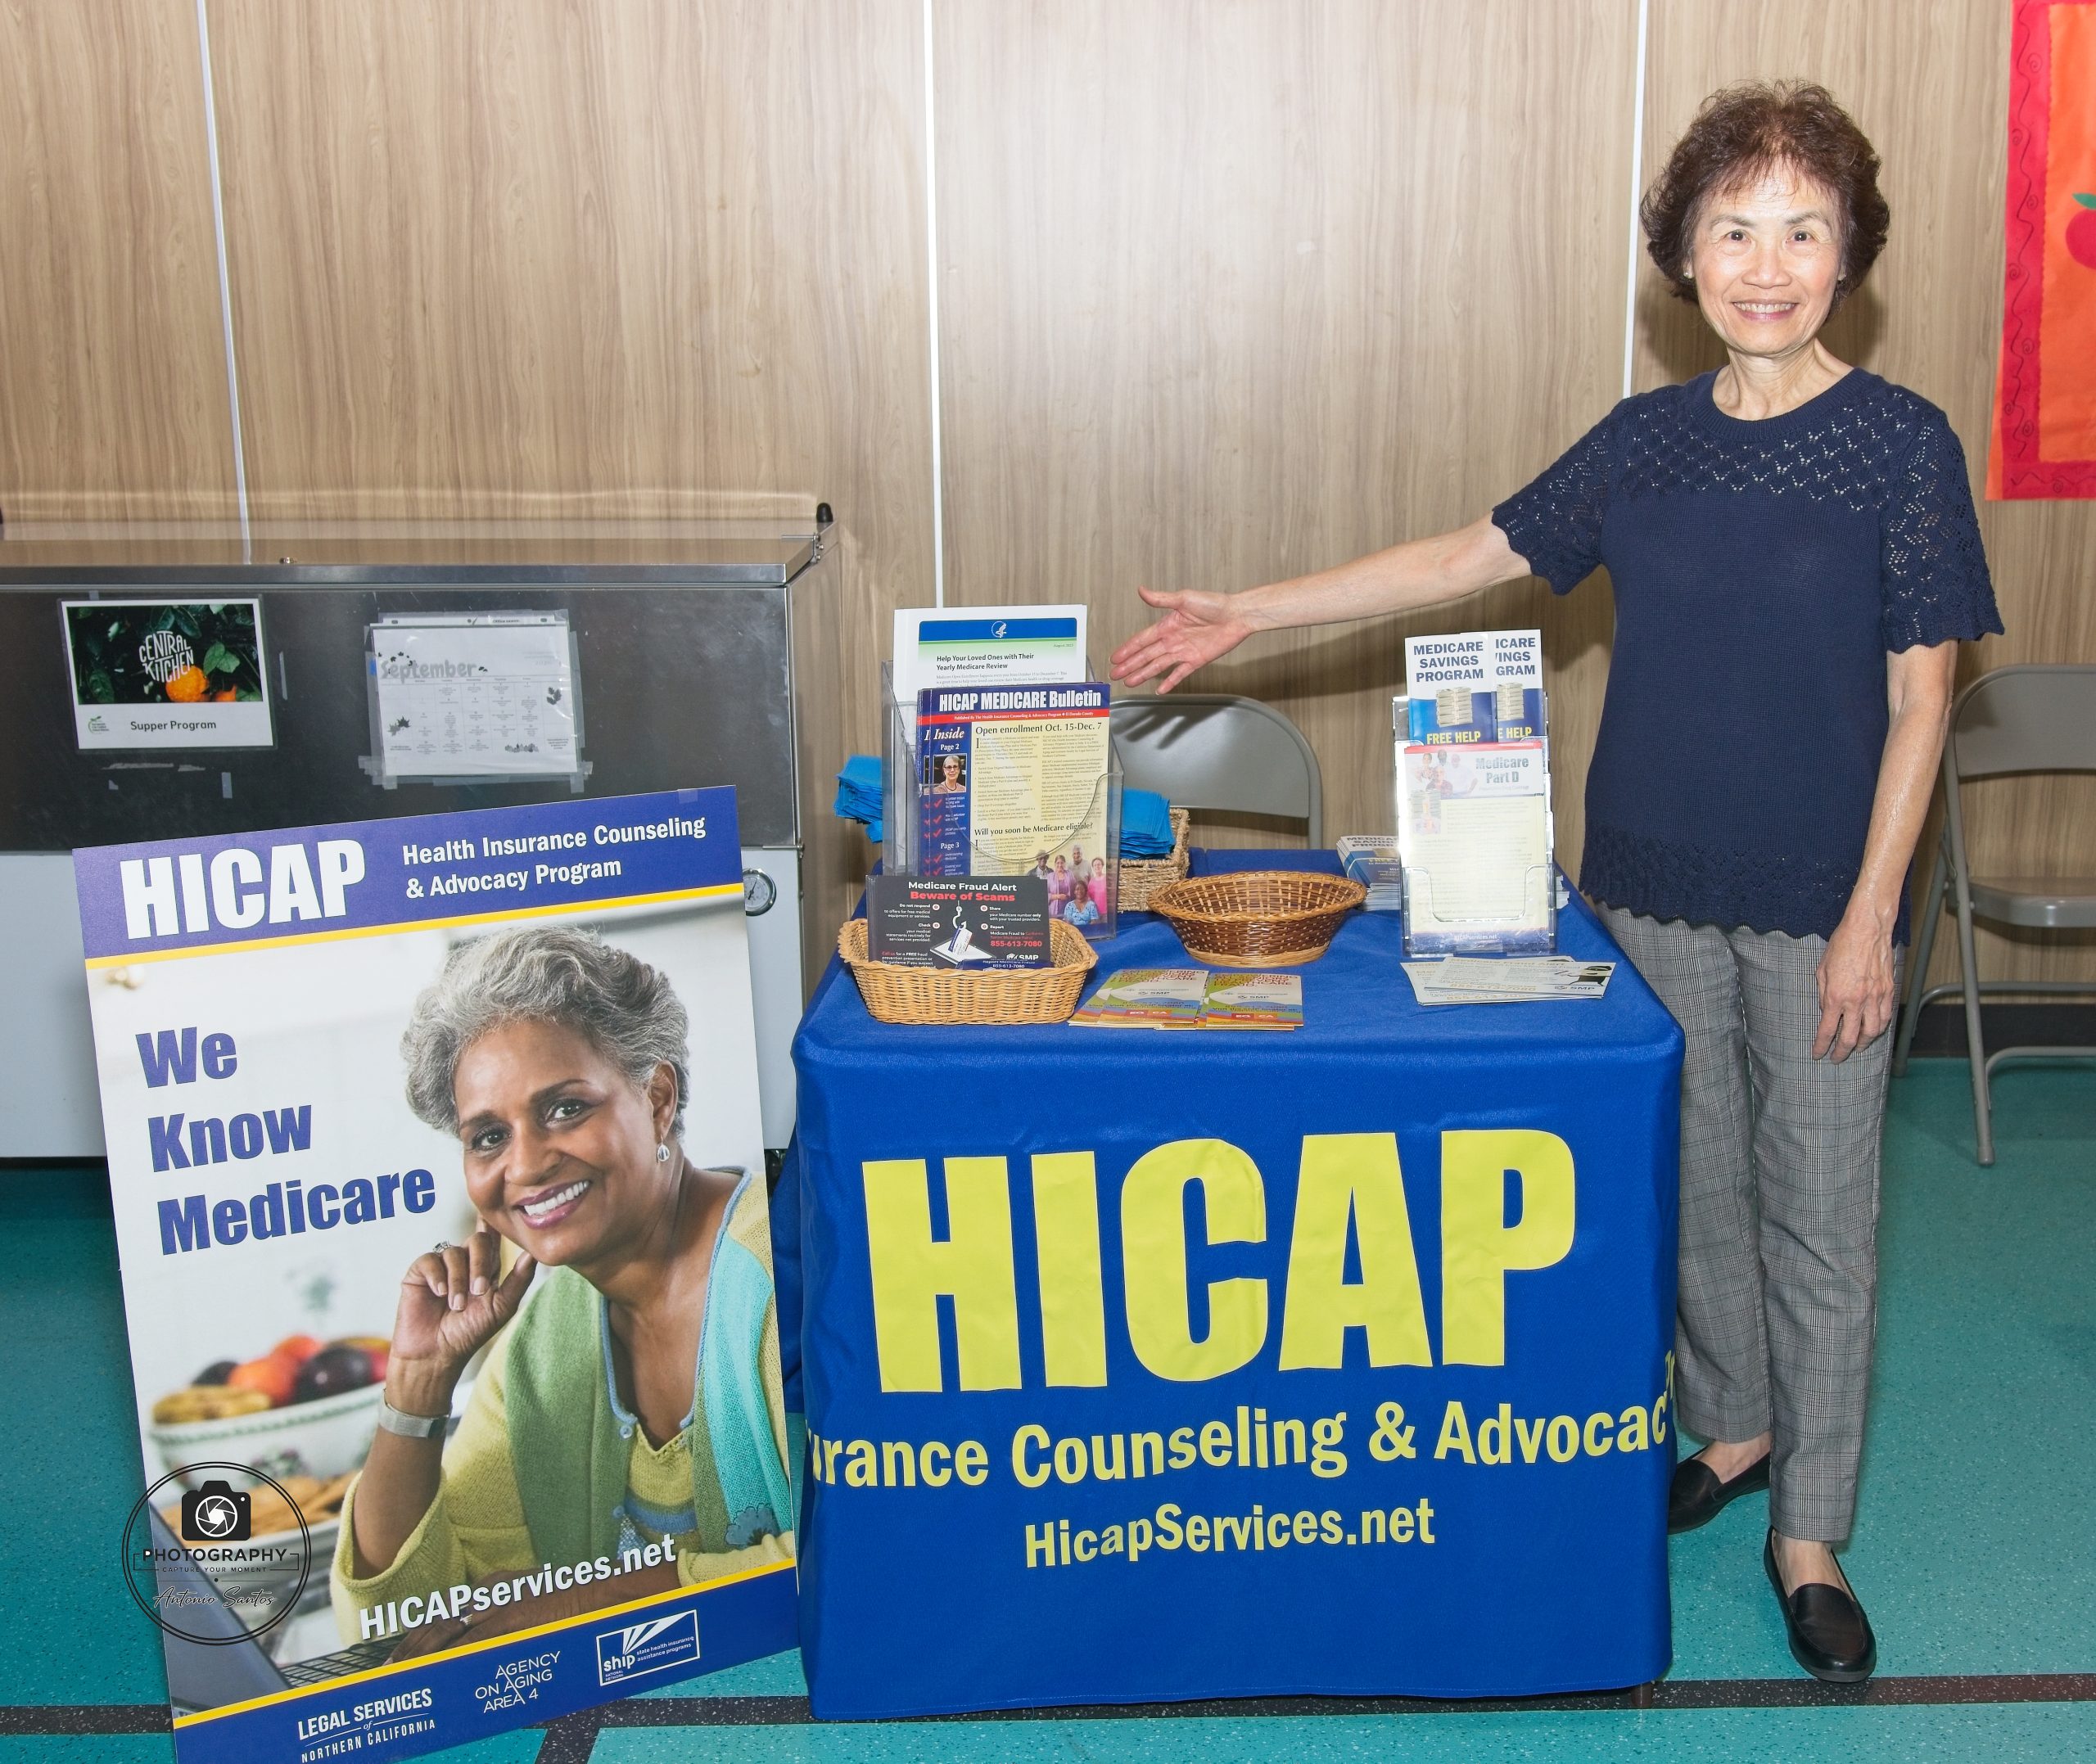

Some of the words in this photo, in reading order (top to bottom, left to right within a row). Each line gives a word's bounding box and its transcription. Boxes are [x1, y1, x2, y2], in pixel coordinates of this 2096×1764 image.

[138, 630, 191, 663] CENTRAL
[1413, 641, 1484, 656] MEDICARE
[142, 649, 194, 683] KITCHEN
[381, 660, 477, 684] September
[1419, 655, 1479, 669] SAVINGS
[1416, 669, 1484, 683] PROGRAM
[939, 693, 978, 712] HICAP
[980, 691, 1046, 711] MEDICARE
[1049, 689, 1101, 708] Bulletin
[130, 720, 168, 733] Supper
[170, 720, 216, 732] Program
[933, 726, 965, 740] Inside
[975, 726, 998, 737] Open
[1000, 724, 1043, 733] enrollment
[1045, 724, 1062, 732] Oct.
[1064, 723, 1095, 731] 15-Dec.
[1426, 732, 1452, 745] FREE
[1455, 730, 1481, 743] HELP
[1506, 726, 1533, 738] HELP
[940, 743, 955, 751] Page
[1475, 758, 1529, 770] Medicare
[1486, 772, 1509, 784] Part
[1510, 771, 1520, 783] D
[402, 836, 475, 867] Health
[482, 828, 588, 859] Insurance
[594, 815, 707, 849] Counseling
[990, 828, 1003, 837] you
[1033, 824, 1064, 832] Medicare
[1065, 822, 1093, 832] eligible?
[405, 876, 426, 899] &
[430, 864, 530, 898] Advocacy
[535, 856, 622, 887] Program
[908, 881, 956, 890] Medicare
[959, 882, 989, 891] Fraud
[991, 883, 1017, 891] Alert
[119, 838, 366, 941] HICAP
[910, 891, 957, 900] Beware
[960, 892, 973, 900] of
[975, 892, 1015, 901] Scams
[135, 1026, 237, 1089] We
[147, 1104, 312, 1173] Know
[156, 1168, 436, 1256] Medicare
[861, 1129, 1575, 1394] HICAP
[1011, 1405, 1348, 1490] Counseling
[1369, 1401, 1417, 1461] &
[1023, 1497, 1436, 1570] HicapServices.net
[359, 1532, 677, 1640] HICAPservices.net
[636, 1648, 650, 1656] state
[651, 1644, 667, 1652] health
[667, 1635, 694, 1648] insurance
[637, 1650, 666, 1662] assistance
[666, 1643, 692, 1655] programs
[495, 1650, 562, 1681] AGENCY
[603, 1654, 635, 1672] ship
[474, 1681, 501, 1700] ON
[504, 1669, 553, 1695] AGING
[483, 1692, 526, 1714] AREA
[528, 1689, 540, 1701] 4
[297, 1711, 351, 1741] LEGAL
[354, 1687, 433, 1722] SERVICES
[362, 1720, 373, 1731] of
[300, 1736, 363, 1764] NORTHERN
[367, 1719, 436, 1747] CALIFORNIA
